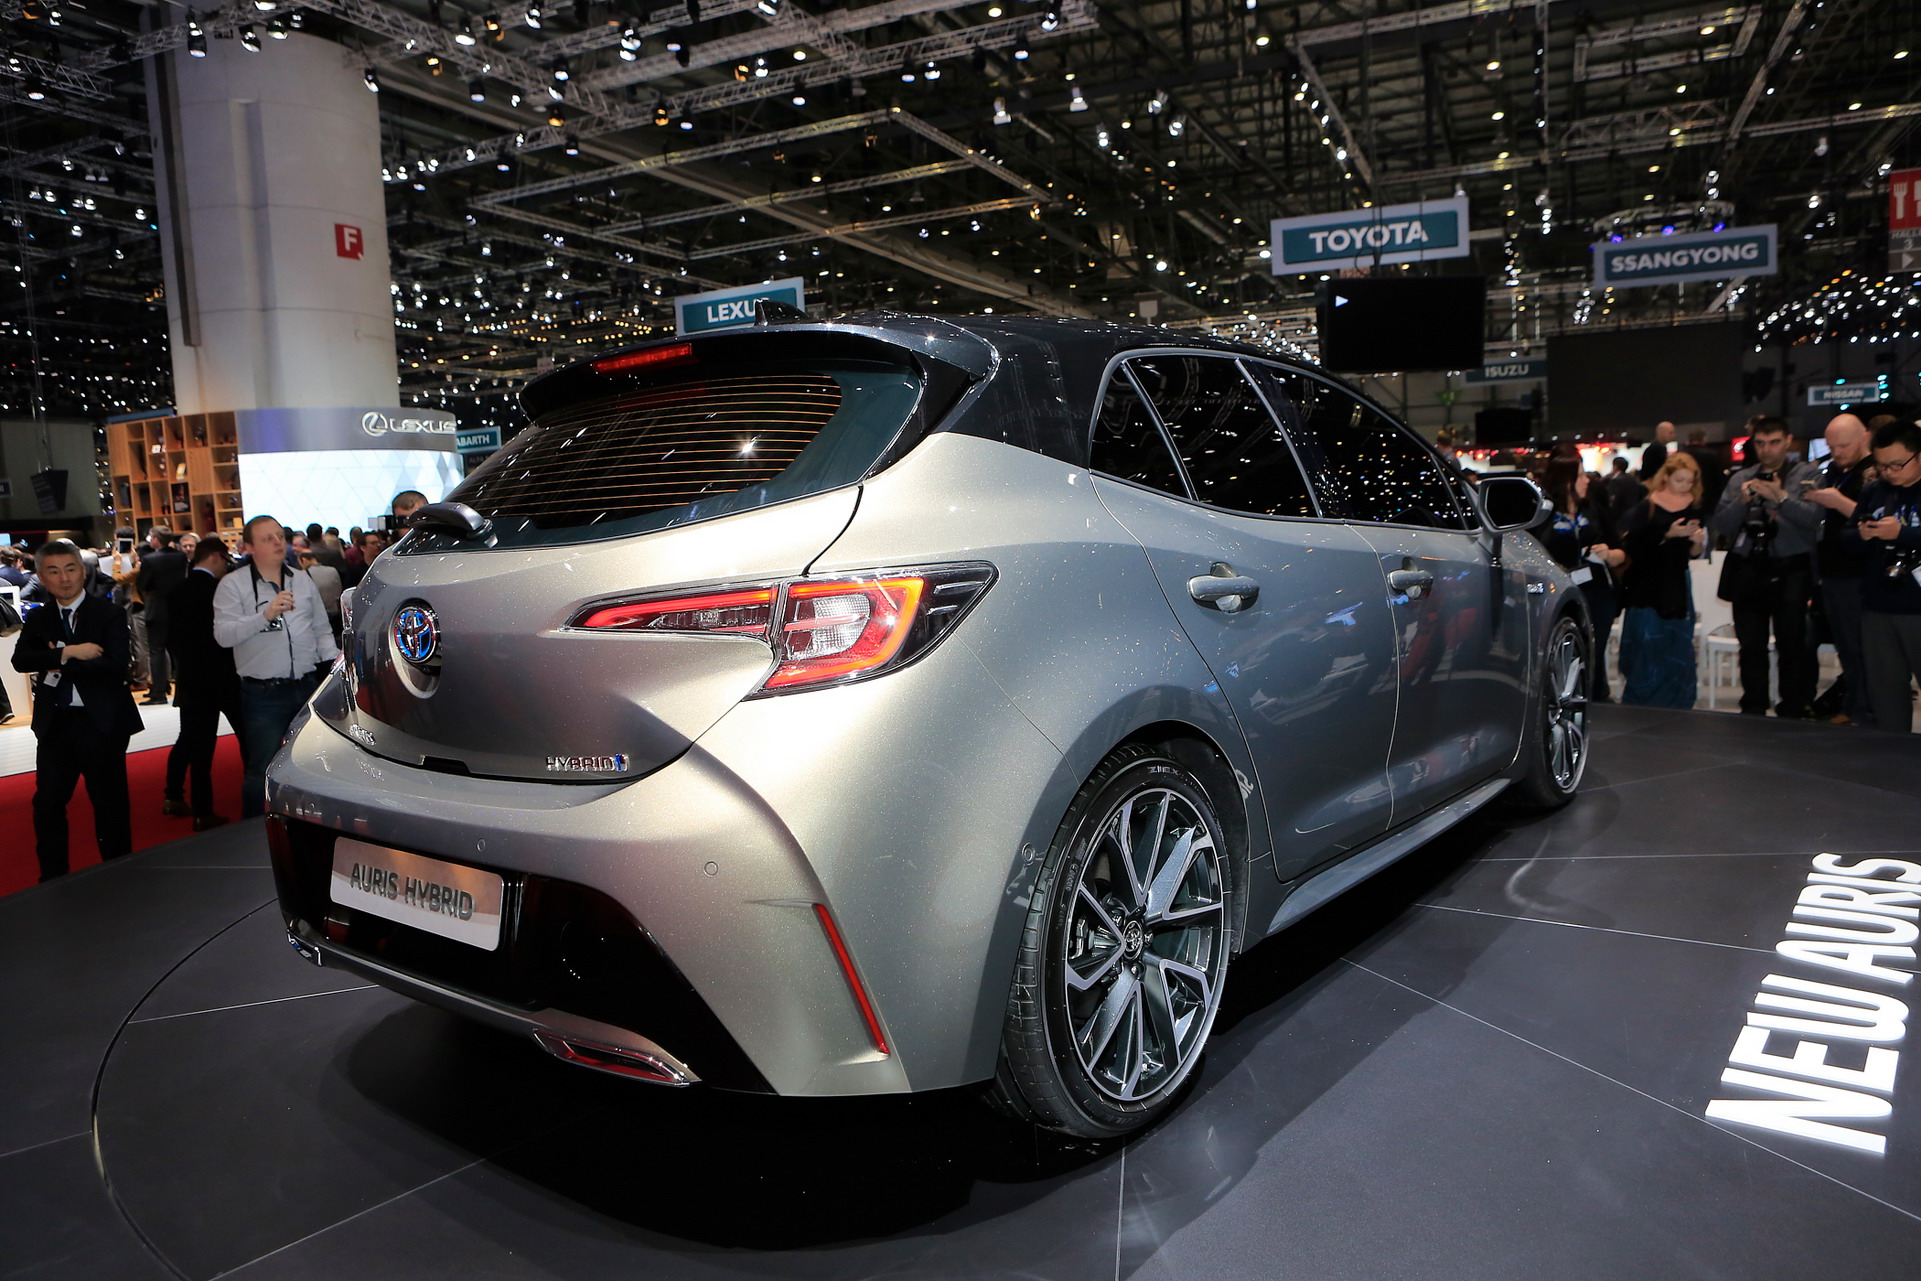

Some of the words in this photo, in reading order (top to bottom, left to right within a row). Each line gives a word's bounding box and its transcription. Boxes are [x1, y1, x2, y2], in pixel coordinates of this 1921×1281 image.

[343, 226, 358, 251] F
[1309, 220, 1429, 254] TOYOTA
[1611, 242, 1759, 273] SSANGYONG
[707, 297, 769, 323] LEXU
[1485, 363, 1529, 378] ISUZU
[389, 418, 456, 434] LEXUS
[546, 756, 616, 772] HYBRID
[351, 862, 399, 900] AURIS
[405, 876, 475, 922] HYBRID
[1775, 852, 1921, 984] AURIS
[1705, 973, 1910, 1155] NEU
